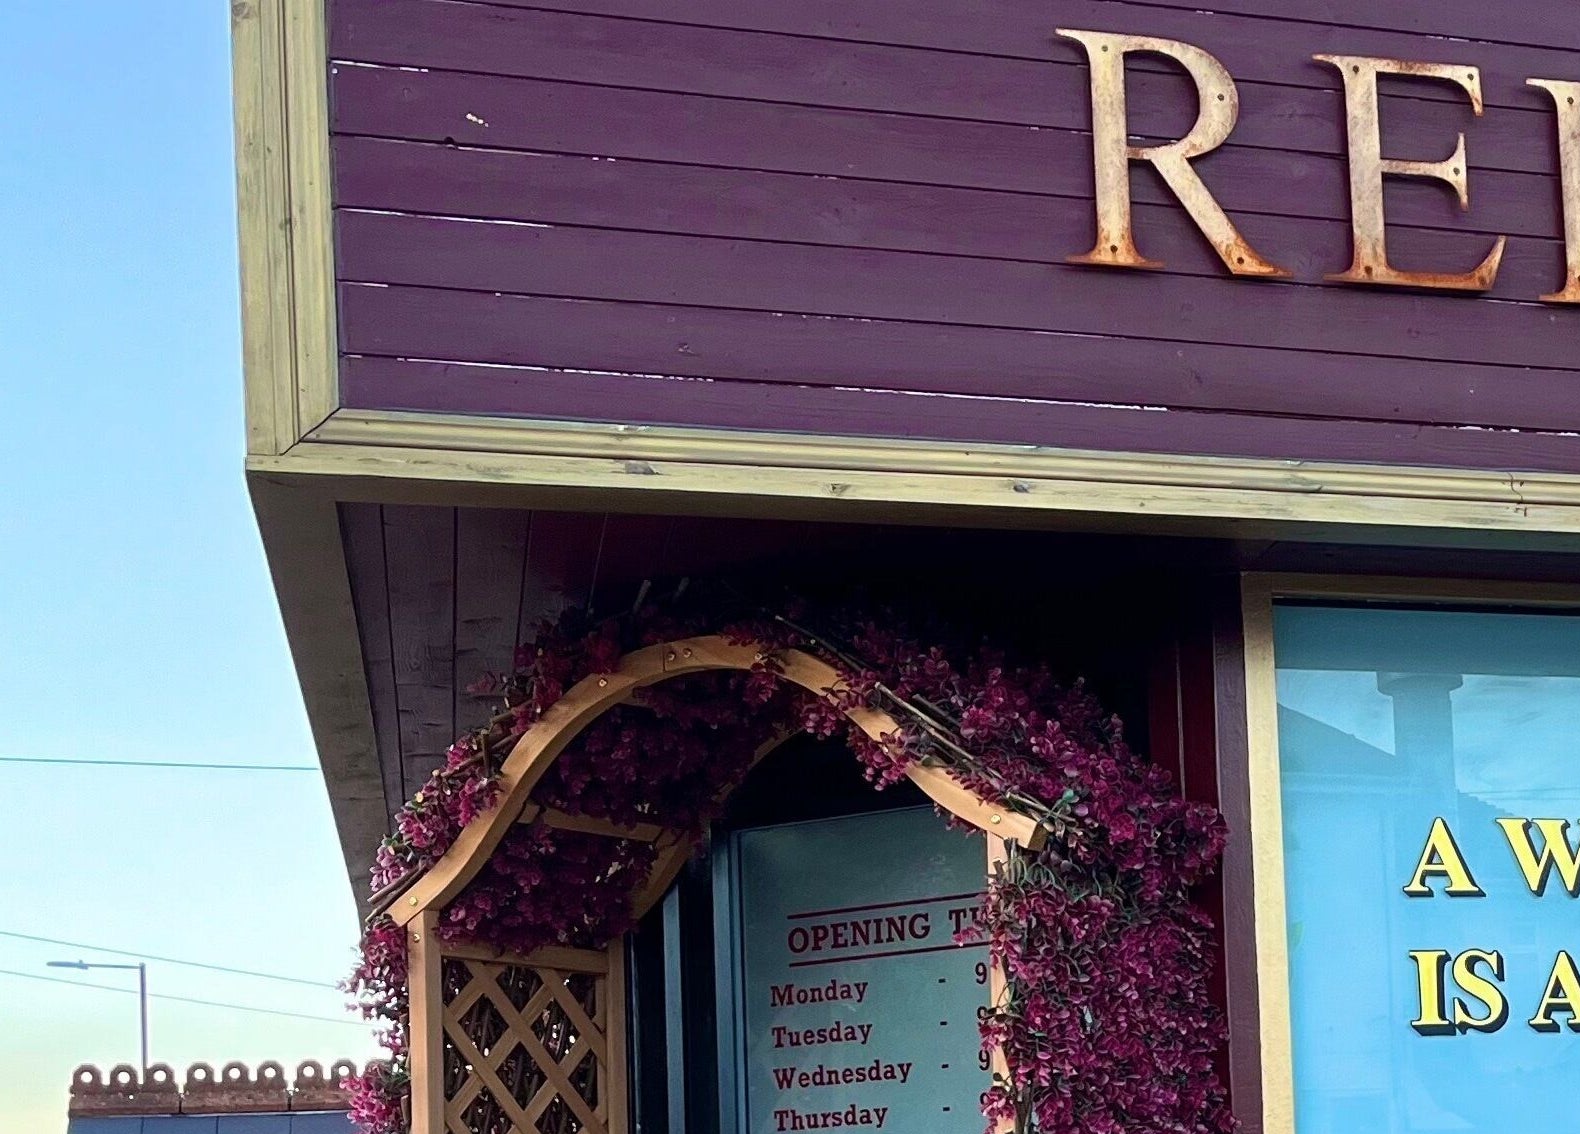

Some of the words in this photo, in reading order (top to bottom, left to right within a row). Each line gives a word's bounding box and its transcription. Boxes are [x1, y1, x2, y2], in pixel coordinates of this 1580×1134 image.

[1403, 818, 1486, 897] A
[787, 912, 932, 953] OPENING
[771, 977, 869, 1007] Monday
[1409, 949, 1508, 1036] IS
[771, 1021, 873, 1048] Tuesday
[773, 1060, 913, 1090] Wednesday
[774, 1104, 888, 1132] Thursday
